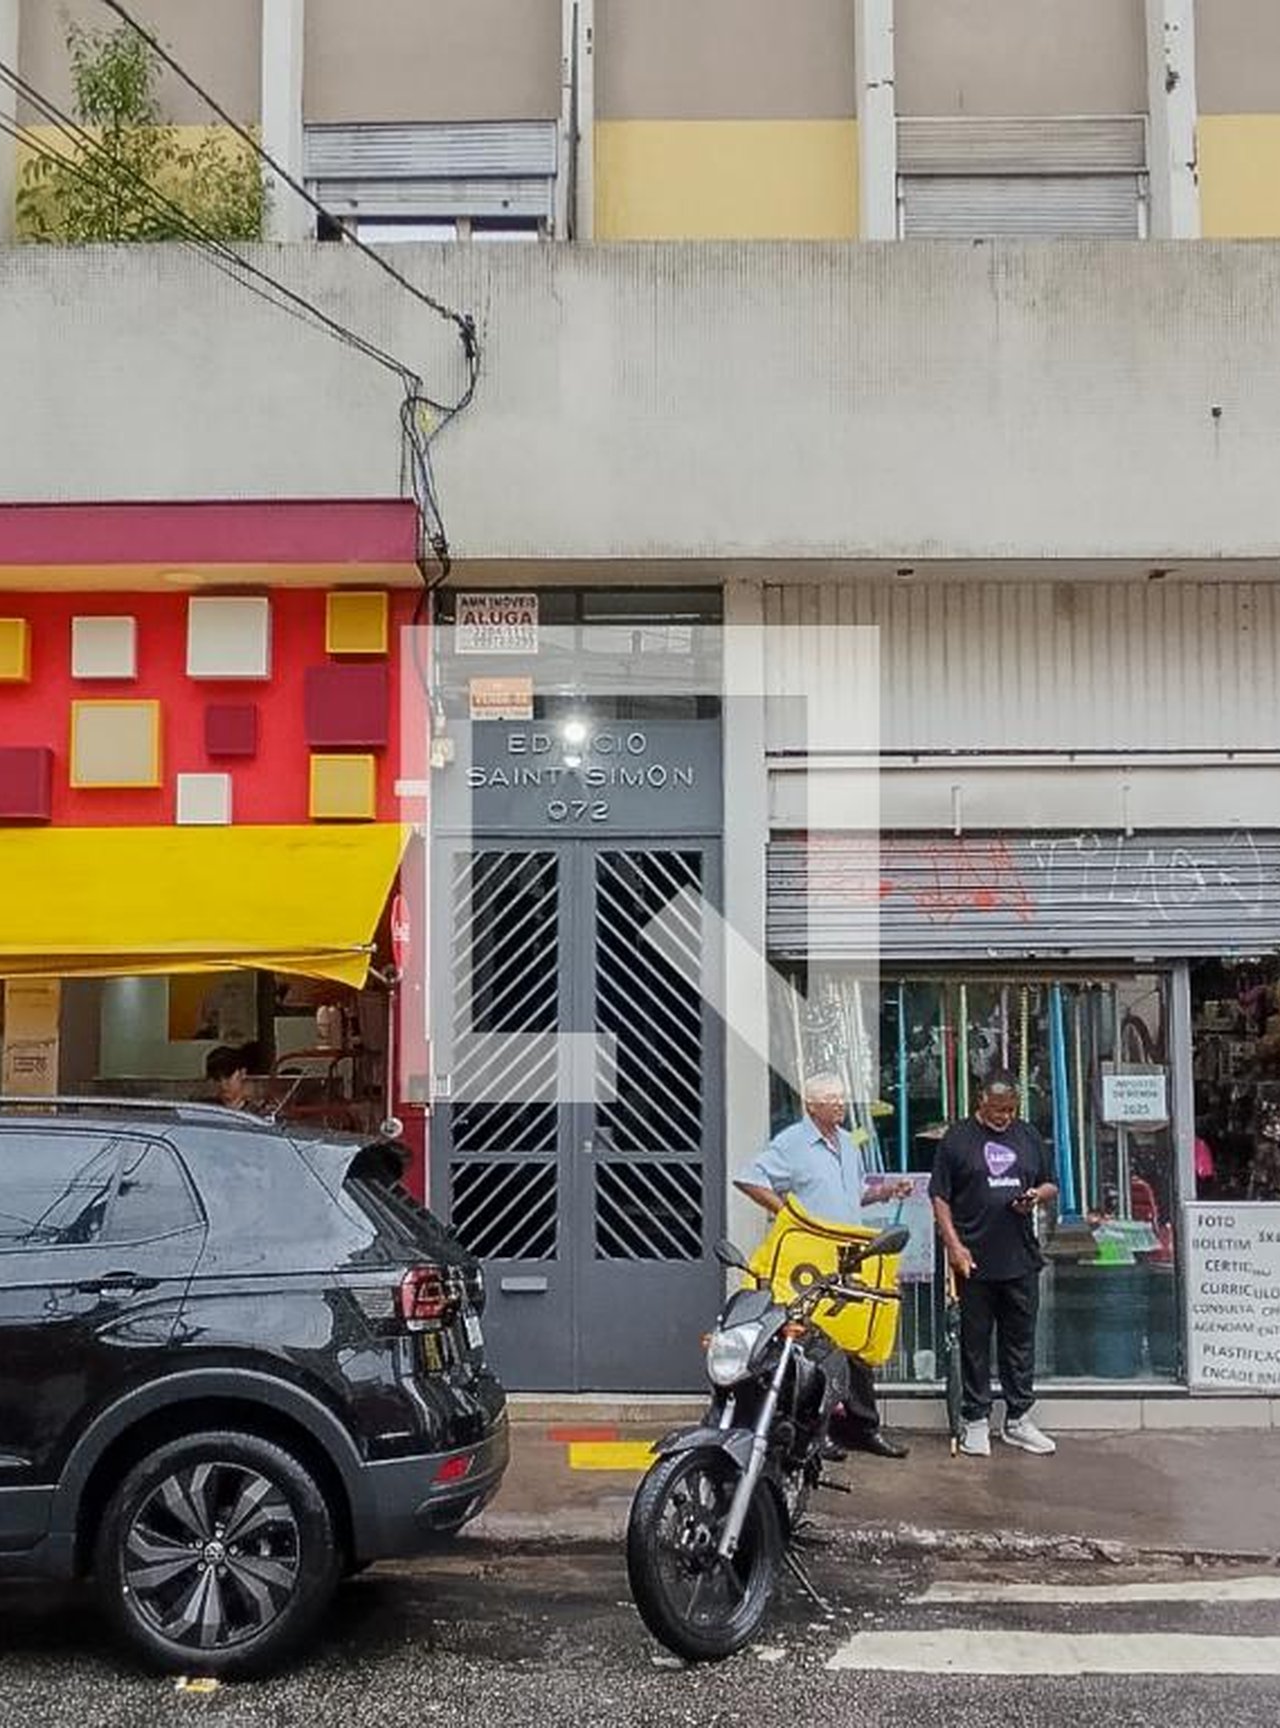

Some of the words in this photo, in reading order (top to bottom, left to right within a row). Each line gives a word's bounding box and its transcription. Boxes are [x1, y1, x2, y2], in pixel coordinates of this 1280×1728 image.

[464, 611, 533, 626] ALUGA
[507, 731, 648, 754] EDCIO
[465, 765, 566, 788] SAINT
[585, 763, 695, 788] SIMON
[1198, 1214, 1235, 1228] FOTO
[1192, 1238, 1252, 1251] BOLETIM
